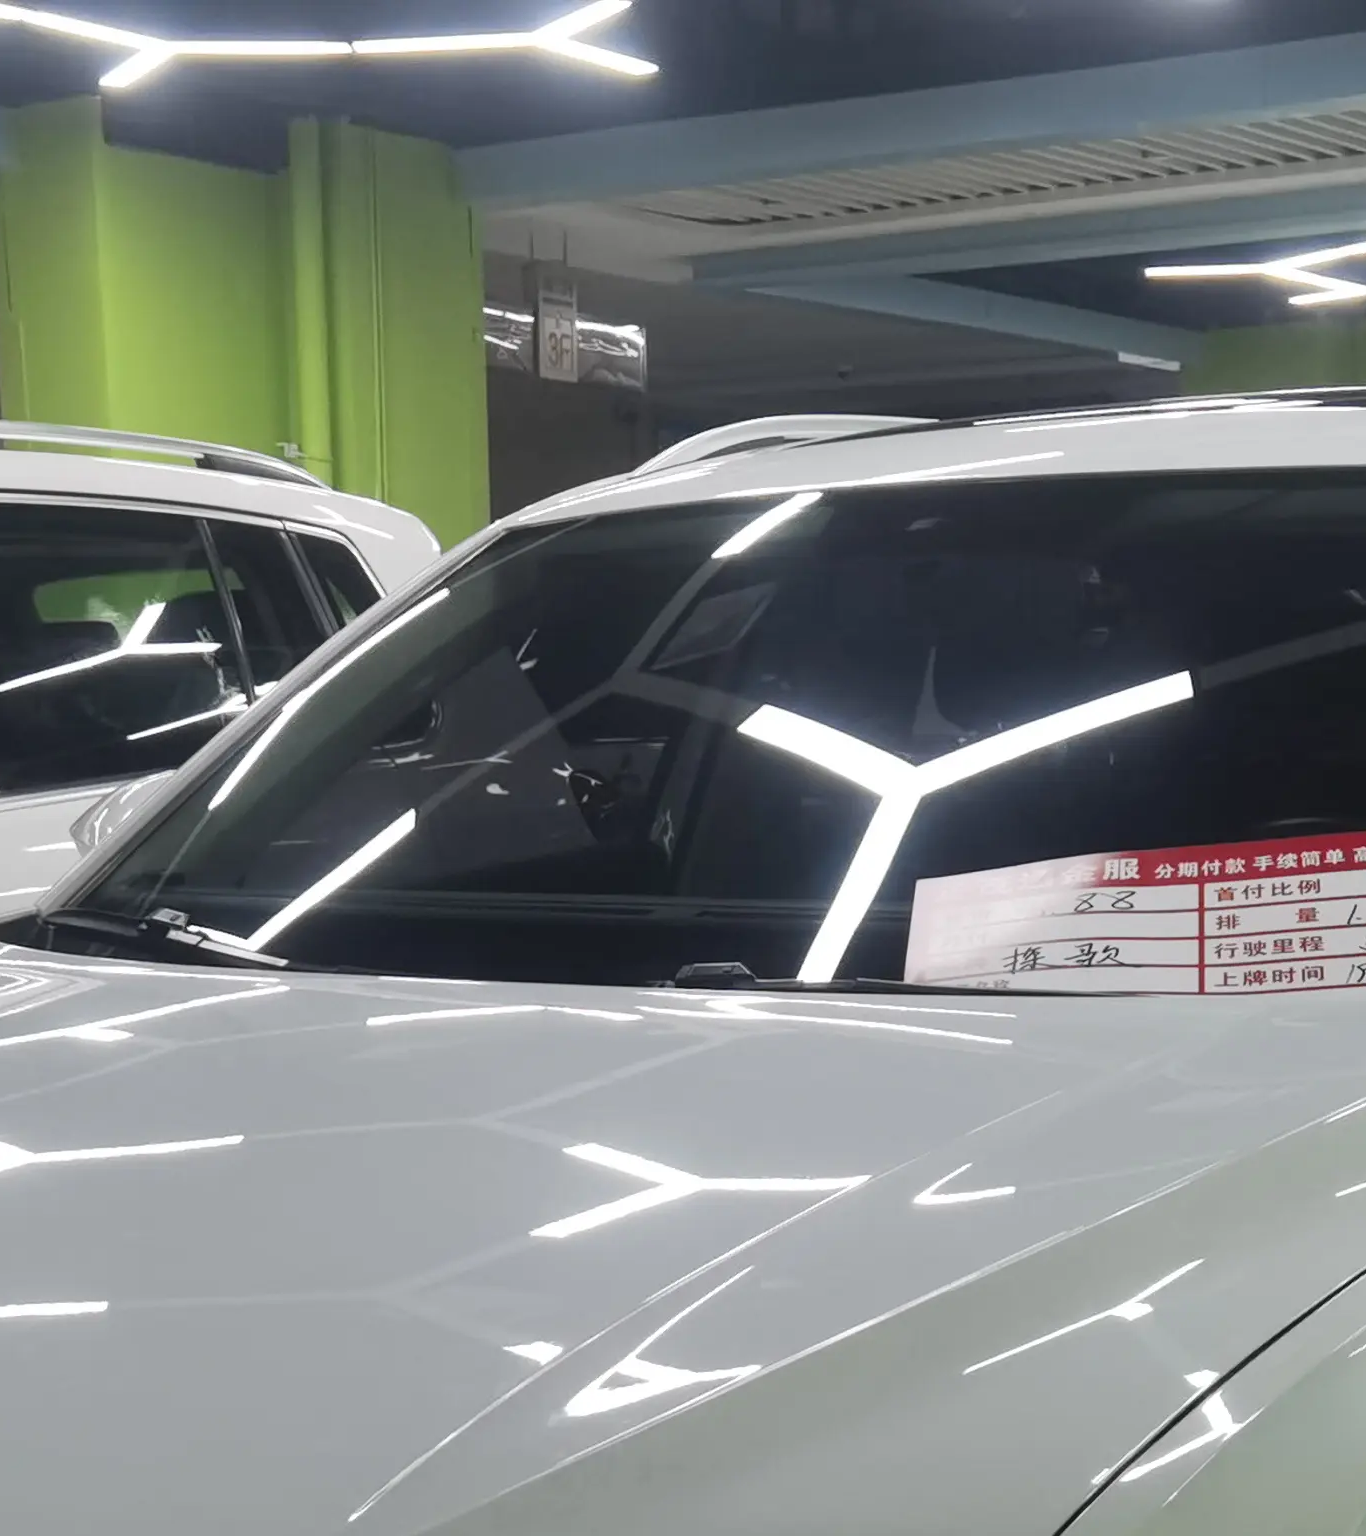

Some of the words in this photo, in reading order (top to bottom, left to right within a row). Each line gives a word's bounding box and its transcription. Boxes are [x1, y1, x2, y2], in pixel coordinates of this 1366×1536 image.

[1154, 858, 1246, 880] 分期付款
[1253, 847, 1346, 872] 手续简单
[1214, 878, 1322, 903] 首付比例
[1214, 935, 1325, 960] 行驶里程
[1214, 964, 1325, 988] 上牌时间
